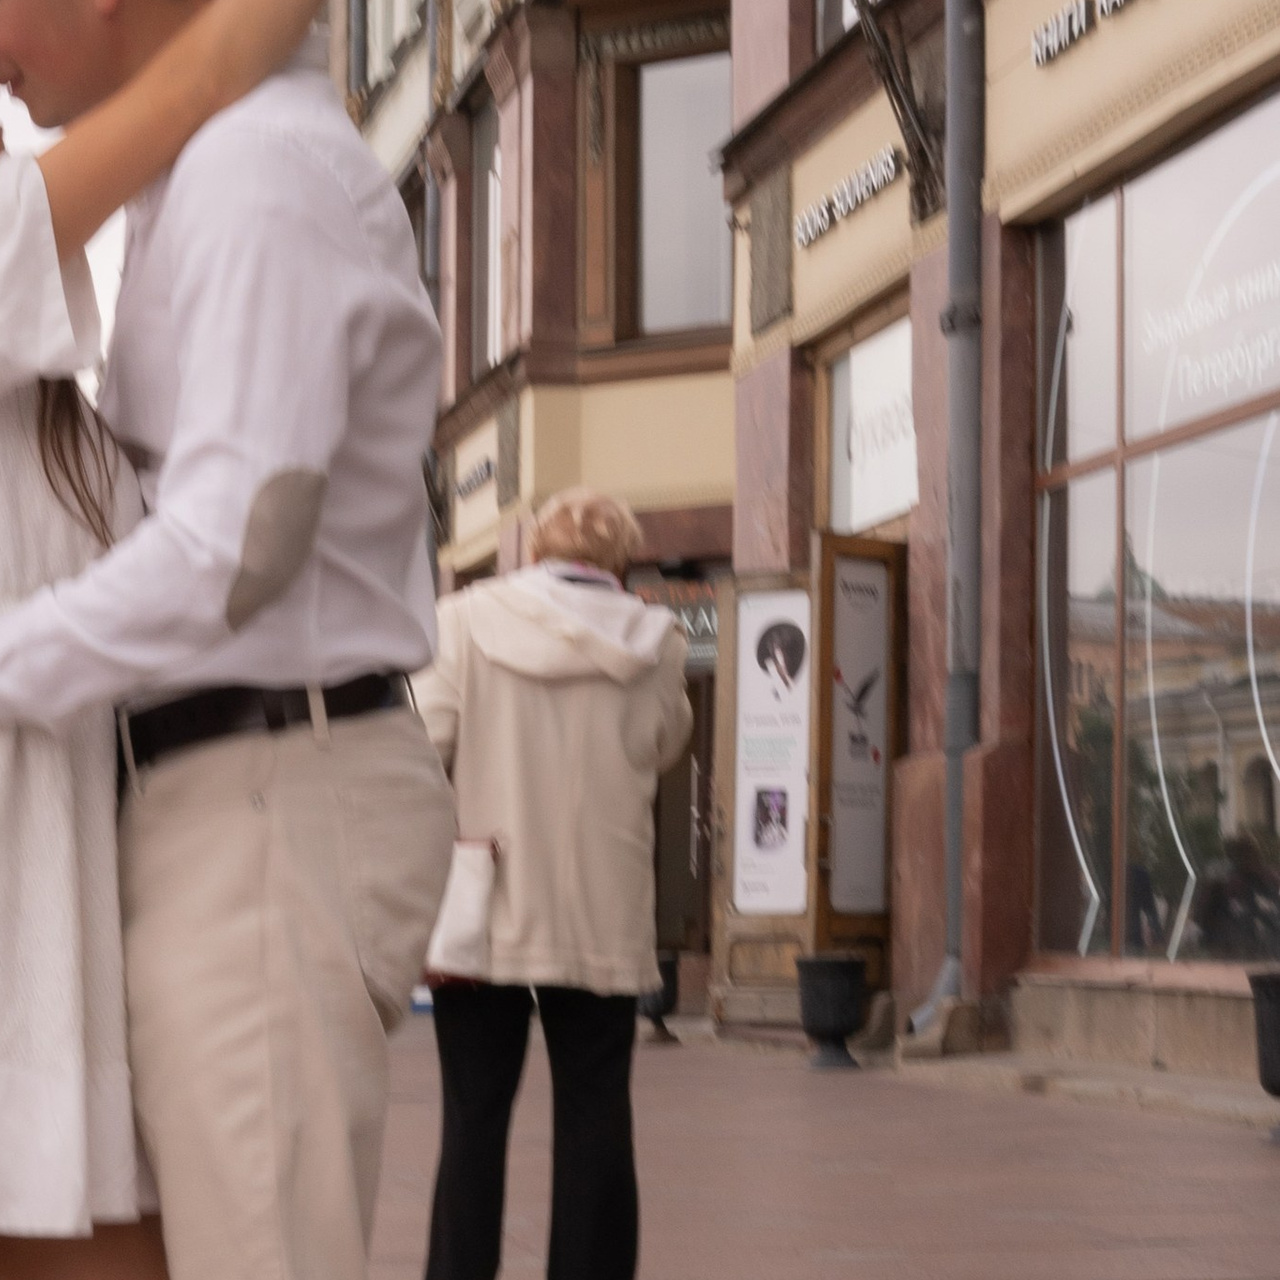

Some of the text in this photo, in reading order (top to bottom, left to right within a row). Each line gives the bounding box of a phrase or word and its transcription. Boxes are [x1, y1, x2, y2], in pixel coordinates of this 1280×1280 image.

[794, 142, 896, 252] BOOKS SOUVENIRS
[1178, 327, 1280, 402] Петербург
